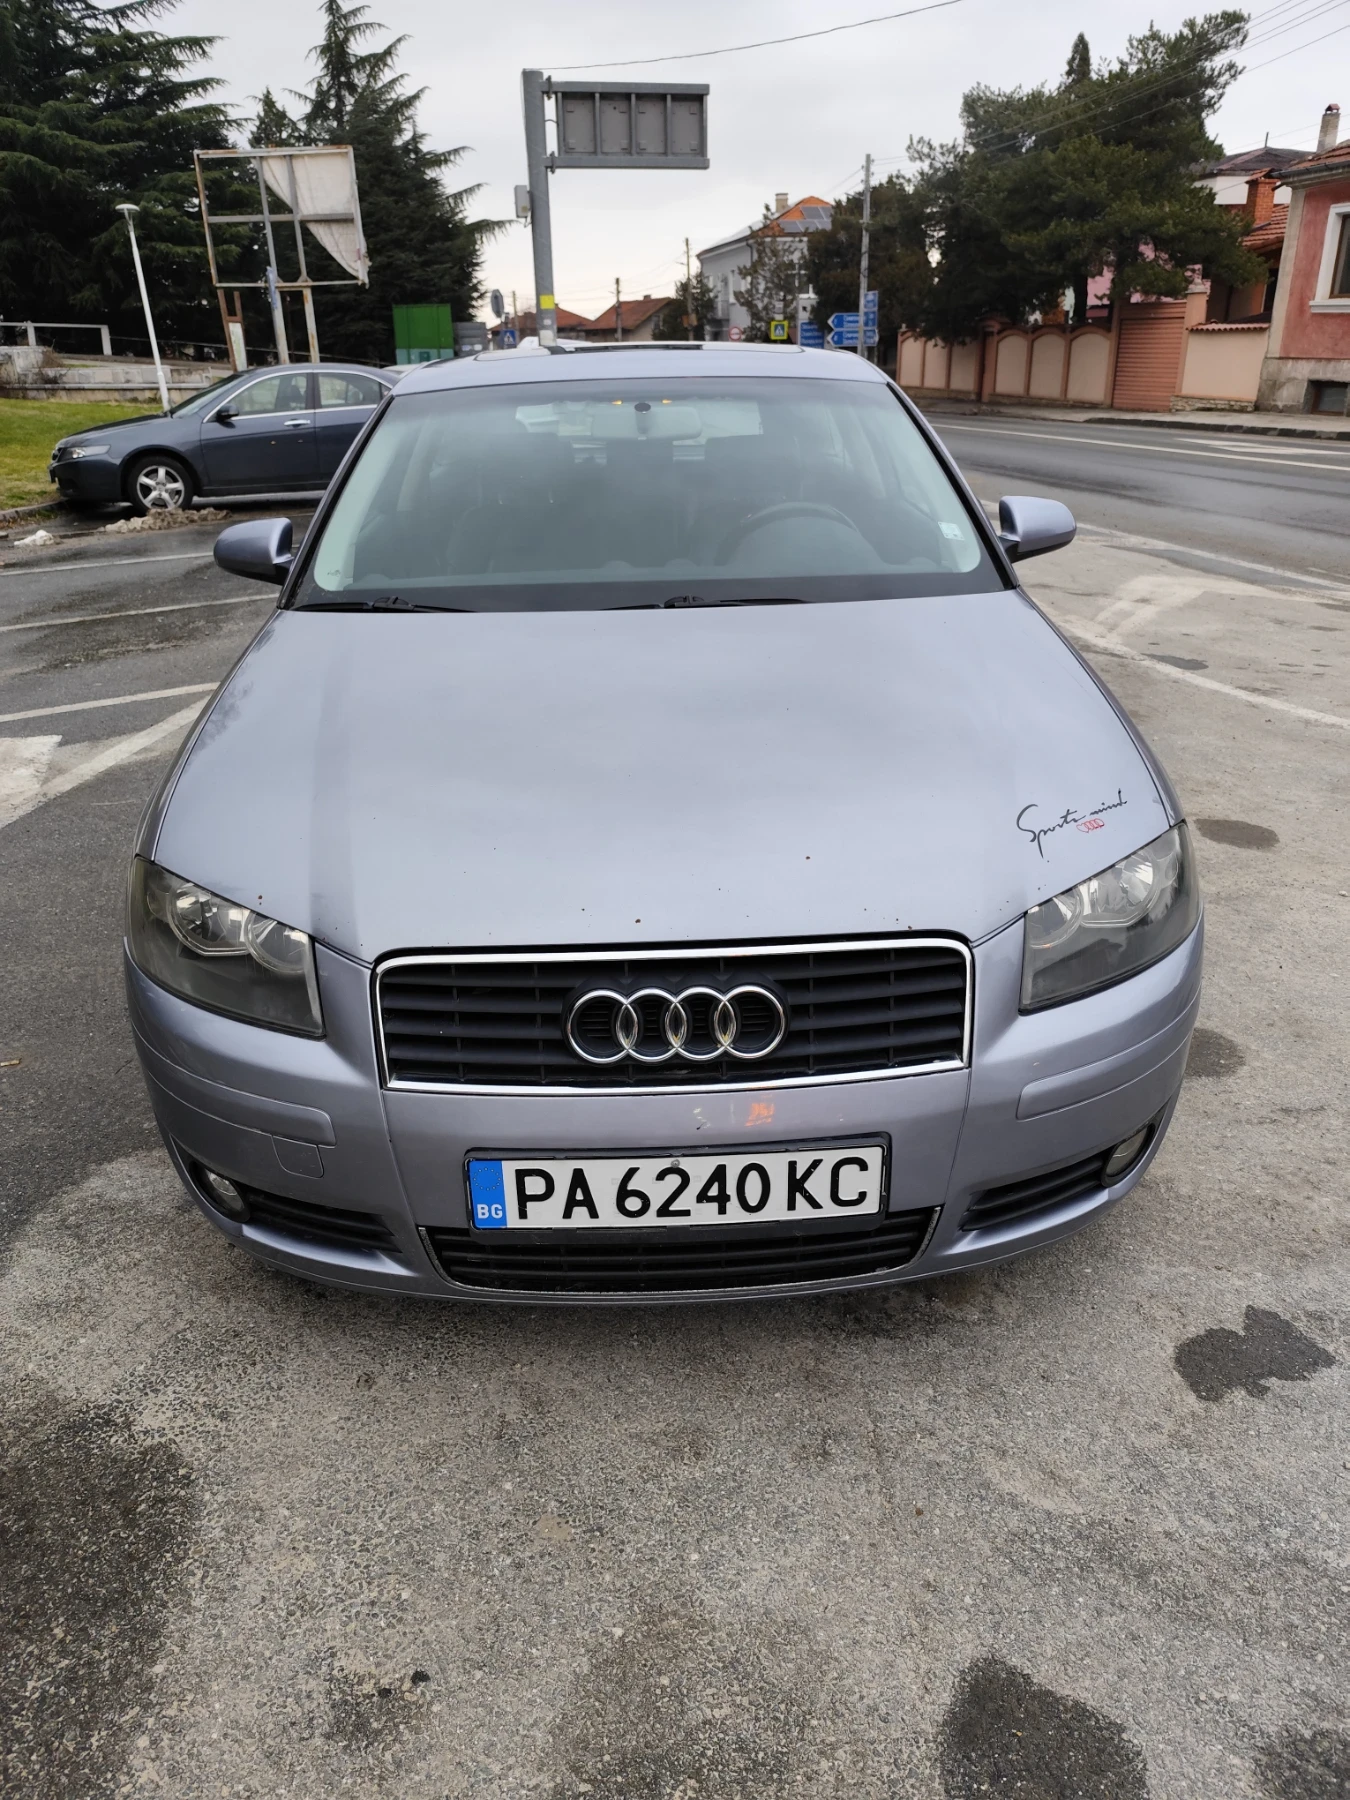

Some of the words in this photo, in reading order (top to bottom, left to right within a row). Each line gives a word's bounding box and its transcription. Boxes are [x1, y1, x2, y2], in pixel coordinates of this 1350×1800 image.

[515, 1167, 600, 1220] PA
[616, 1162, 771, 1219] 6240
[787, 1156, 869, 1212] KC
[477, 1204, 503, 1219] BG
